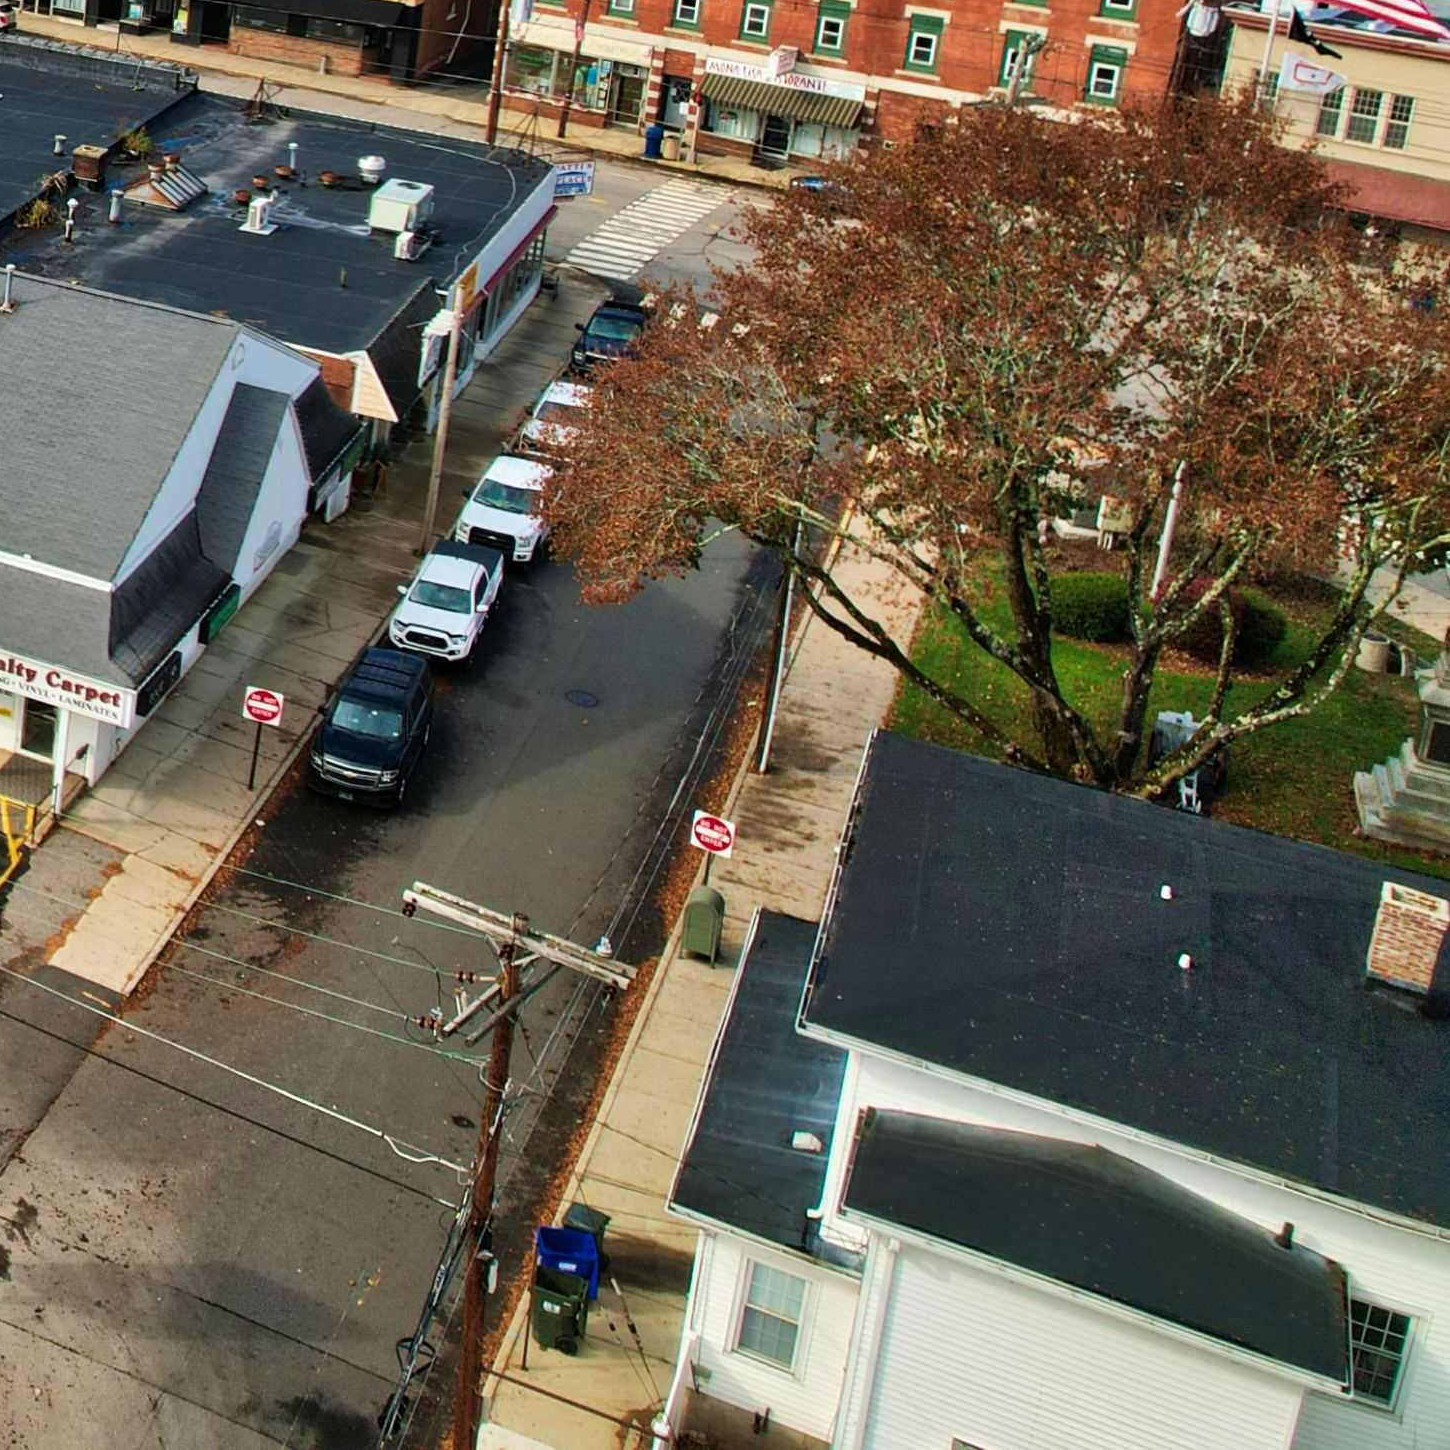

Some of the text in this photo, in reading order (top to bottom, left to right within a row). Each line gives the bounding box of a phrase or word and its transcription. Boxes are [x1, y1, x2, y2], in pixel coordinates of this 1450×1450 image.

[709, 61, 741, 74] MONA
[46, 670, 122, 708] Carpet
[18, 680, 51, 699] VINYL
[58, 694, 119, 720] LAMINATES
[700, 819, 728, 835] DO NOT
[700, 834, 723, 848] ENTER
